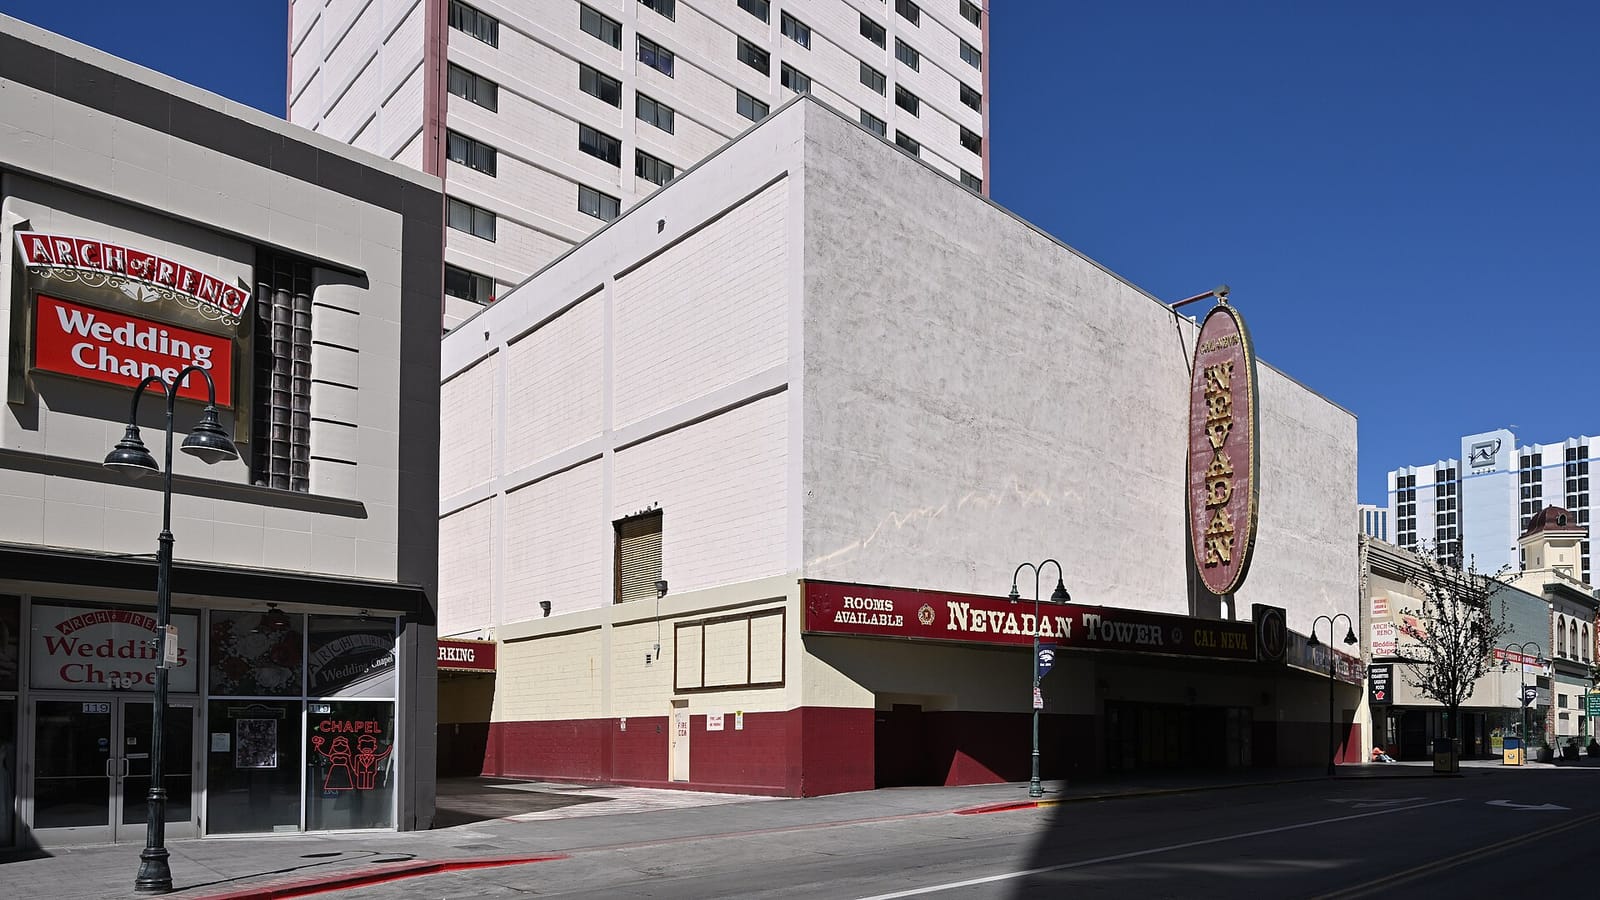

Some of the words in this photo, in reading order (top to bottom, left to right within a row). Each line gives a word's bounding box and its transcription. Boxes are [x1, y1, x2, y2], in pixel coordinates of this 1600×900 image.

[32, 237, 124, 272] ARCH
[159, 265, 241, 311] RENO
[55, 305, 213, 370] Wedding
[71, 342, 190, 388] Chapel
[1204, 361, 1234, 568] NEVADAN
[843, 596, 894, 612] ROOMS
[62, 611, 108, 635] ARCH
[834, 611, 904, 627] AVAILABLE
[947, 601, 1073, 638] NEVADAN
[1082, 612, 1164, 646] TOWER
[1194, 629, 1217, 648] CAL
[1220, 632, 1248, 650] NEVA
[437, 646, 475, 662] RKING
[60, 663, 160, 686] Chape
[106, 678, 133, 689] 119
[85, 704, 109, 713] 119
[320, 720, 382, 734] CHAPEL
